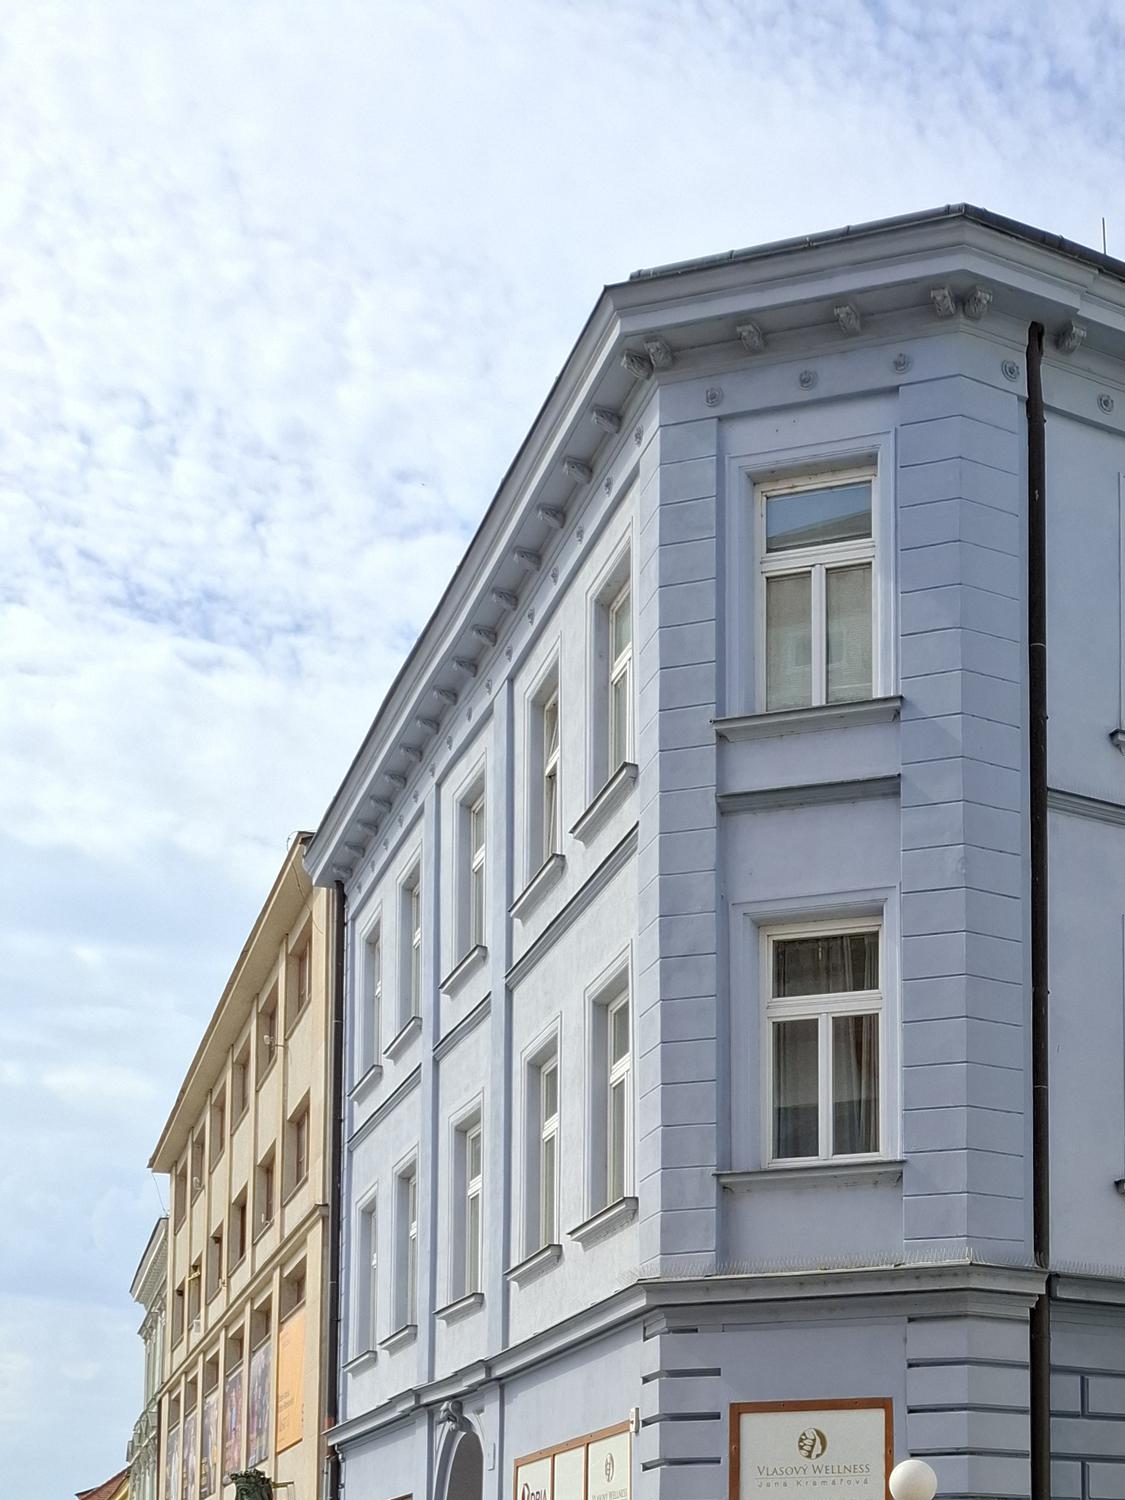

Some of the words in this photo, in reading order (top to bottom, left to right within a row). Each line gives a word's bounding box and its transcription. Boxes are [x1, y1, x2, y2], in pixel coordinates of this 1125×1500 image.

[757, 1464, 808, 1476] VLASOVÝ
[812, 1464, 870, 1475] WELLNESS
[758, 1480, 787, 1488] Jana
[796, 1478, 868, 1487] Kramářová
